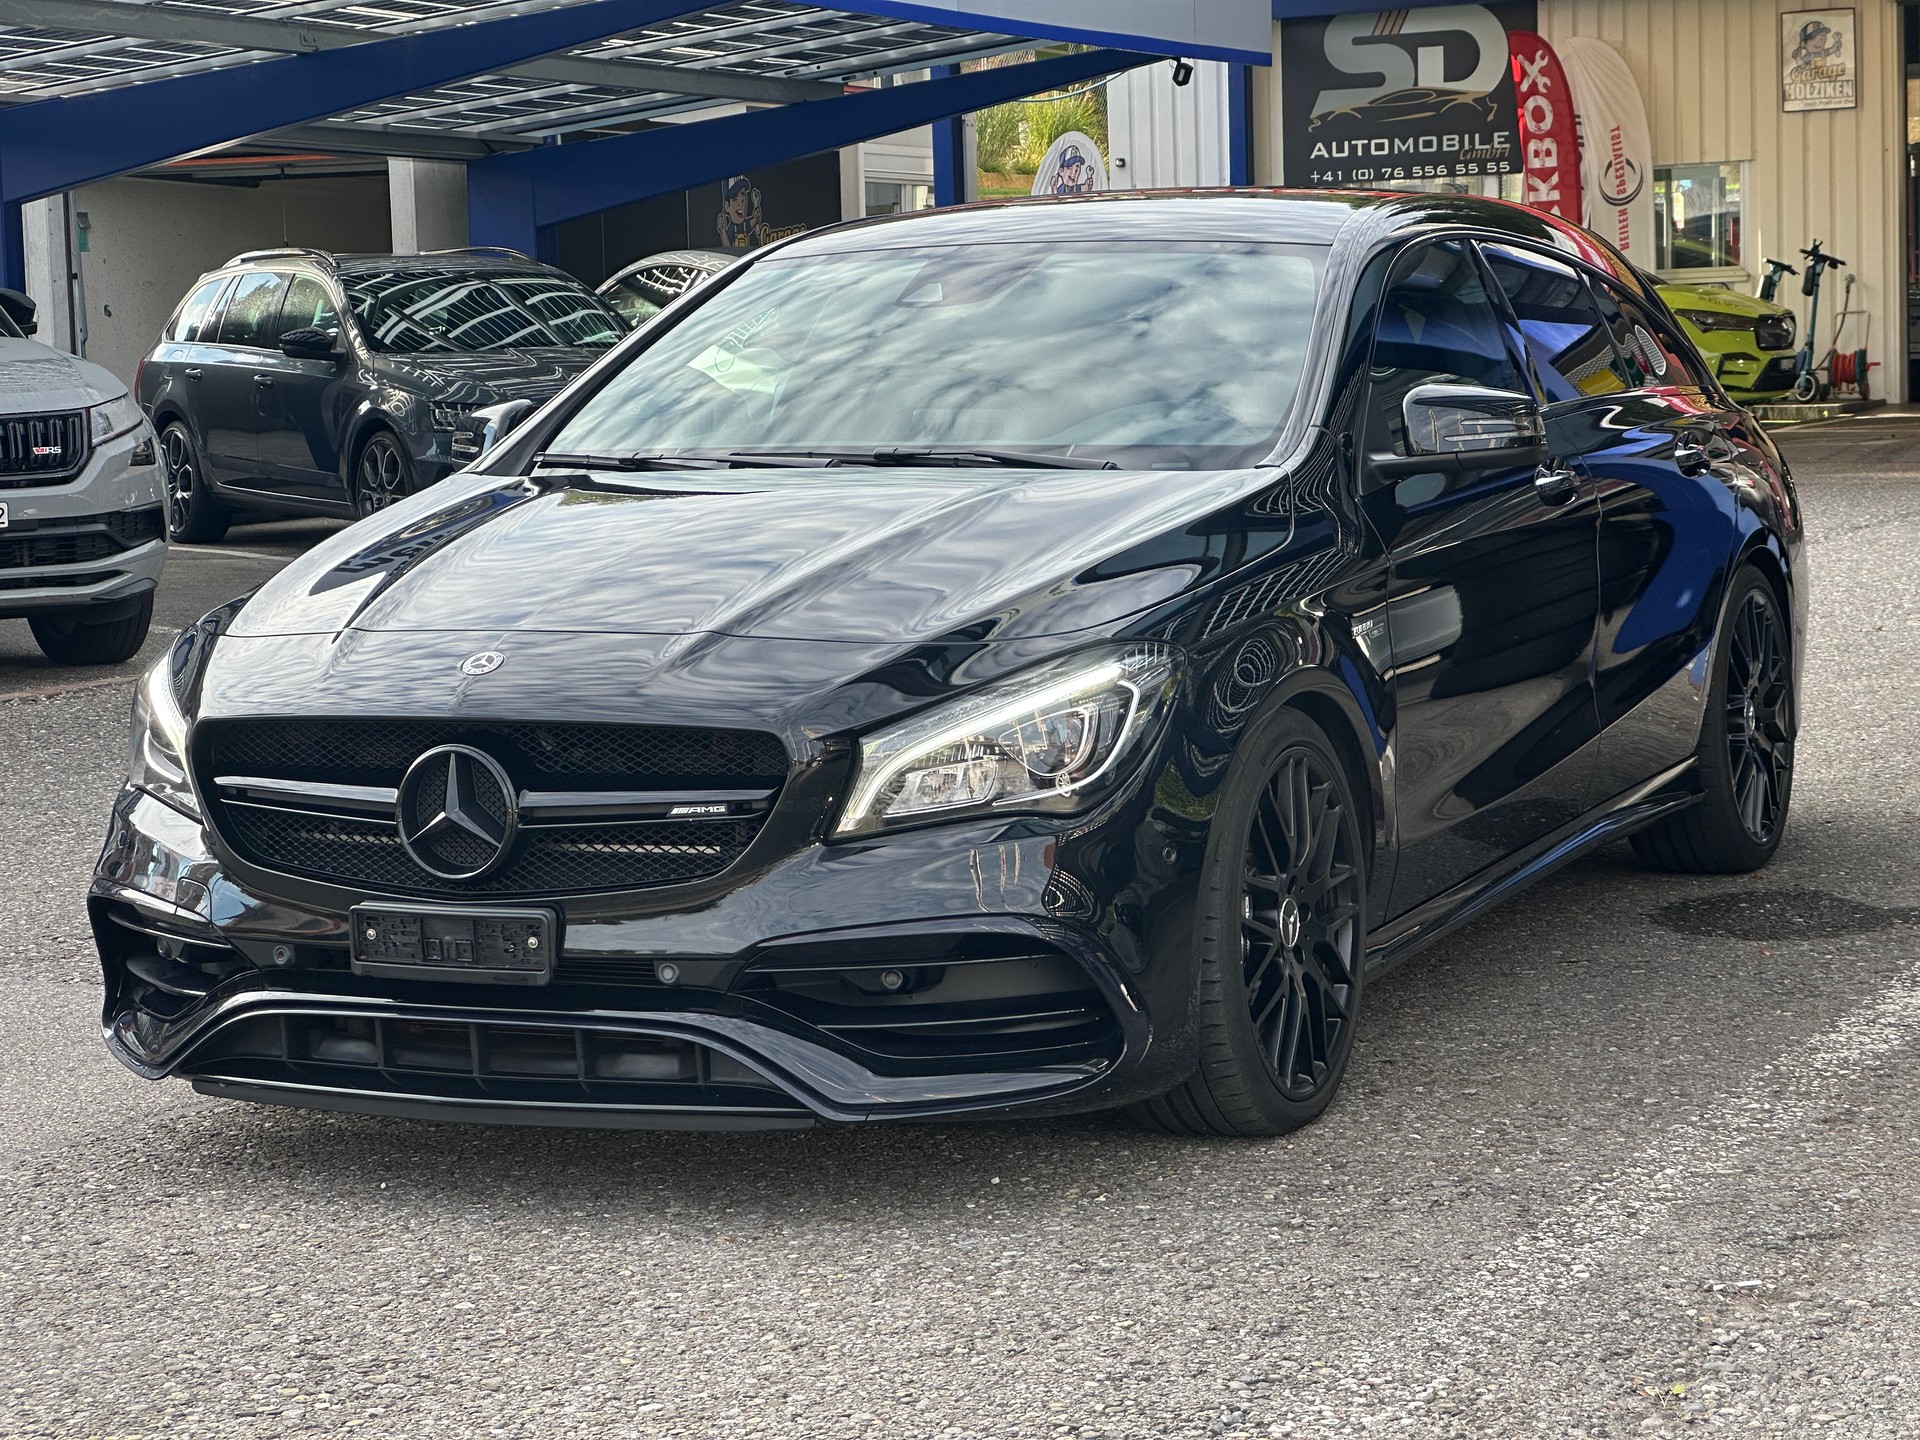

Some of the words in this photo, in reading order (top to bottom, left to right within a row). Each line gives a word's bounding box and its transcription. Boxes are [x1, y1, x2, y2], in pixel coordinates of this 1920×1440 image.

[1310, 4, 1509, 118] SD
[1790, 63, 1845, 84] Garage
[1785, 81, 1853, 100] HOLZIKEN
[1310, 132, 1509, 159] AUTOMOBILE
[1310, 170, 1342, 183] +41
[1352, 168, 1374, 180] (0)
[1381, 167, 1404, 178] 76
[1412, 165, 1447, 177] 556
[1456, 163, 1479, 175] 55
[1487, 161, 1510, 173] 55
